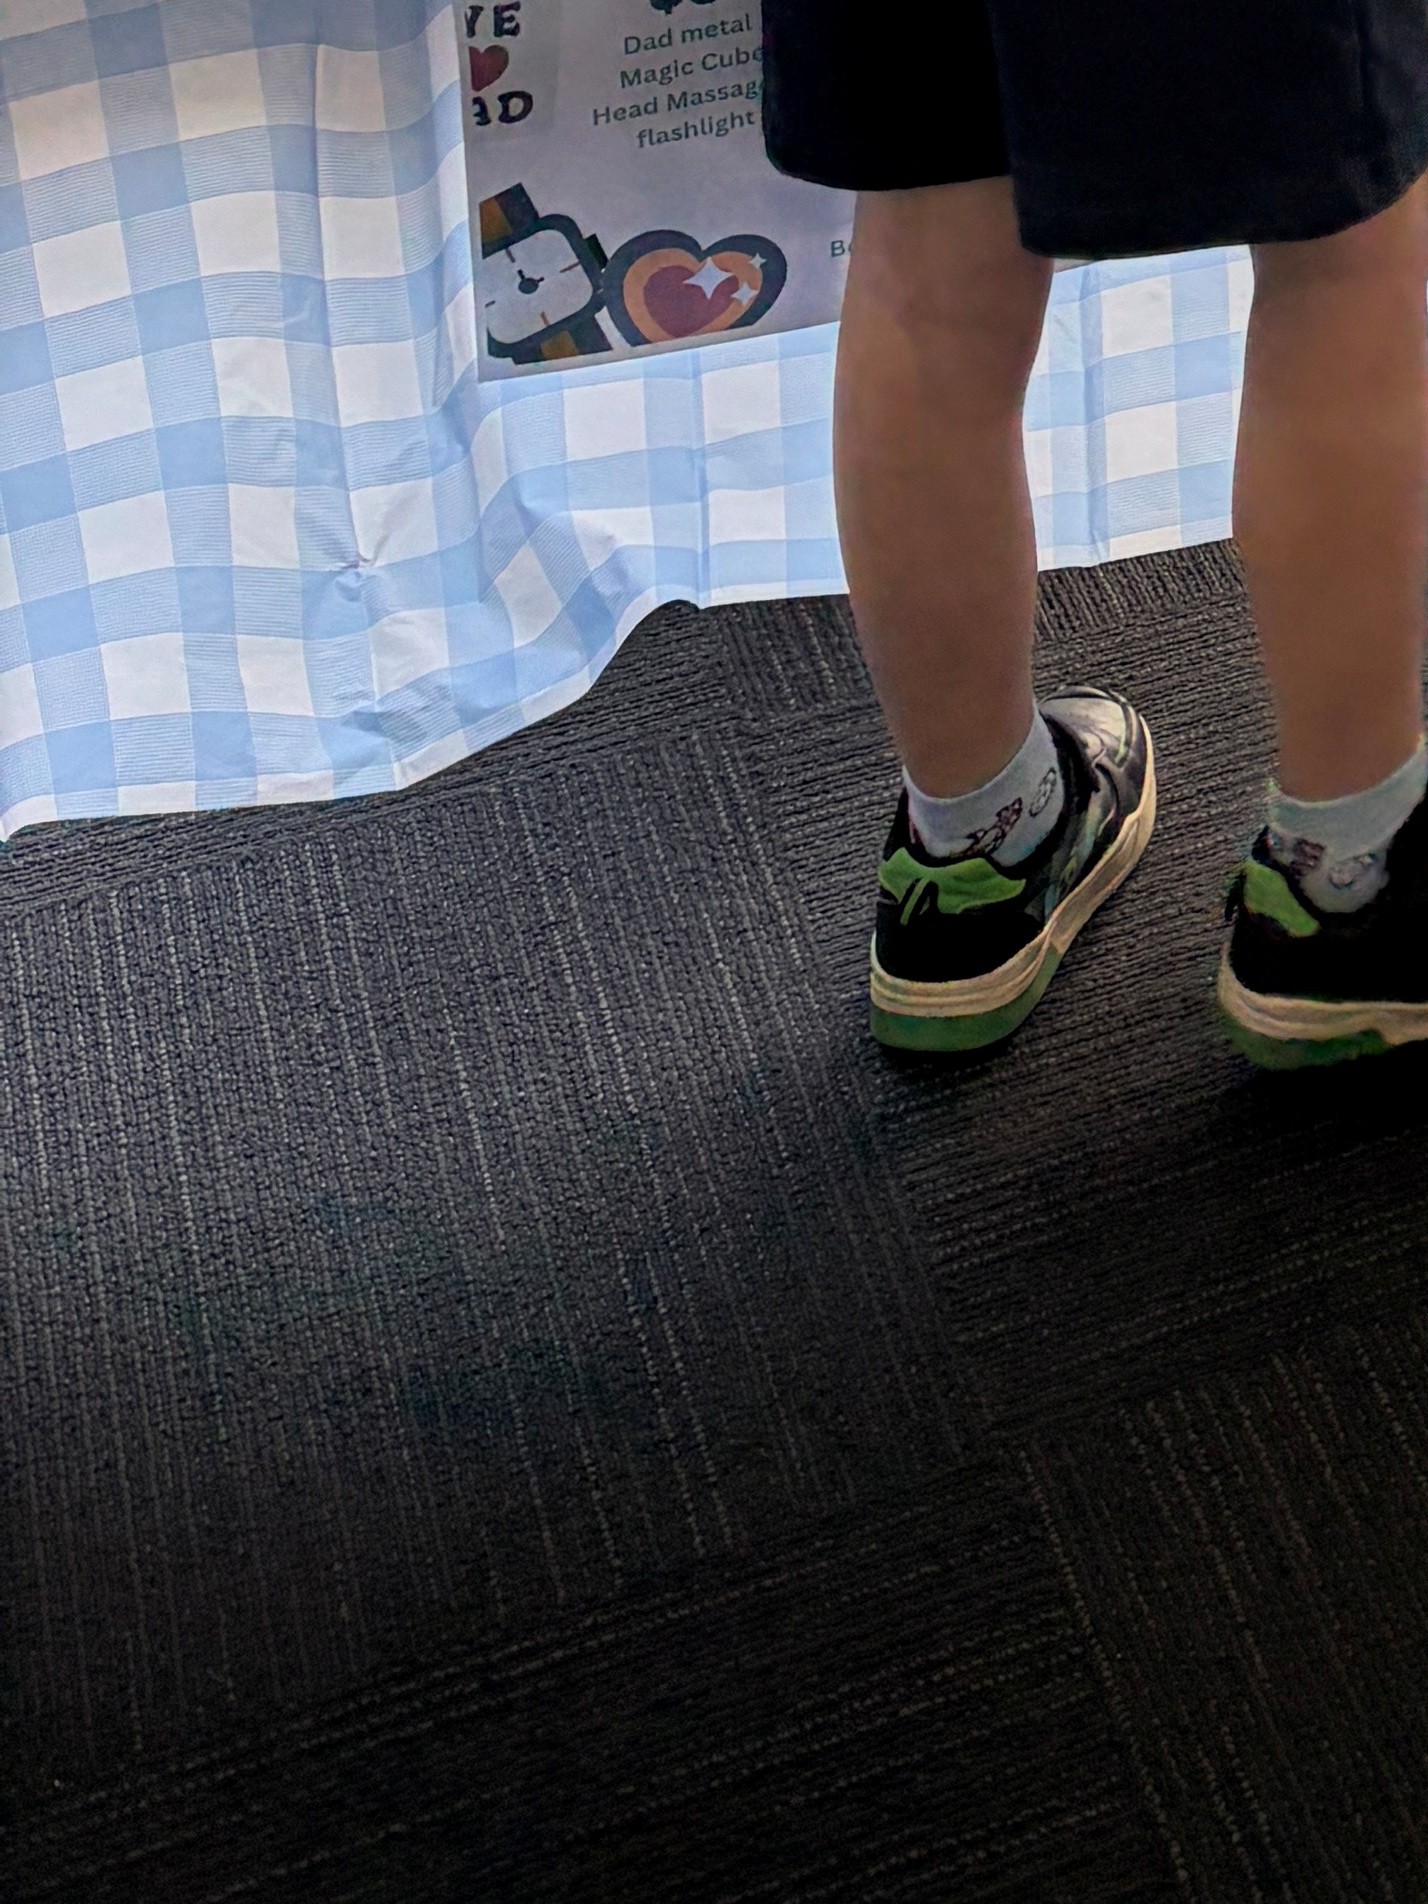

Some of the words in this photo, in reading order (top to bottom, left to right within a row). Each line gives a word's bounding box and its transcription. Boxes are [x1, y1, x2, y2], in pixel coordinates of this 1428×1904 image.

[624, 27, 673, 54] Dad
[680, 14, 753, 44] metal
[619, 60, 694, 89] Magic
[592, 98, 659, 126] Head
[666, 80, 765, 110] Massag
[637, 109, 756, 148] flashlight
